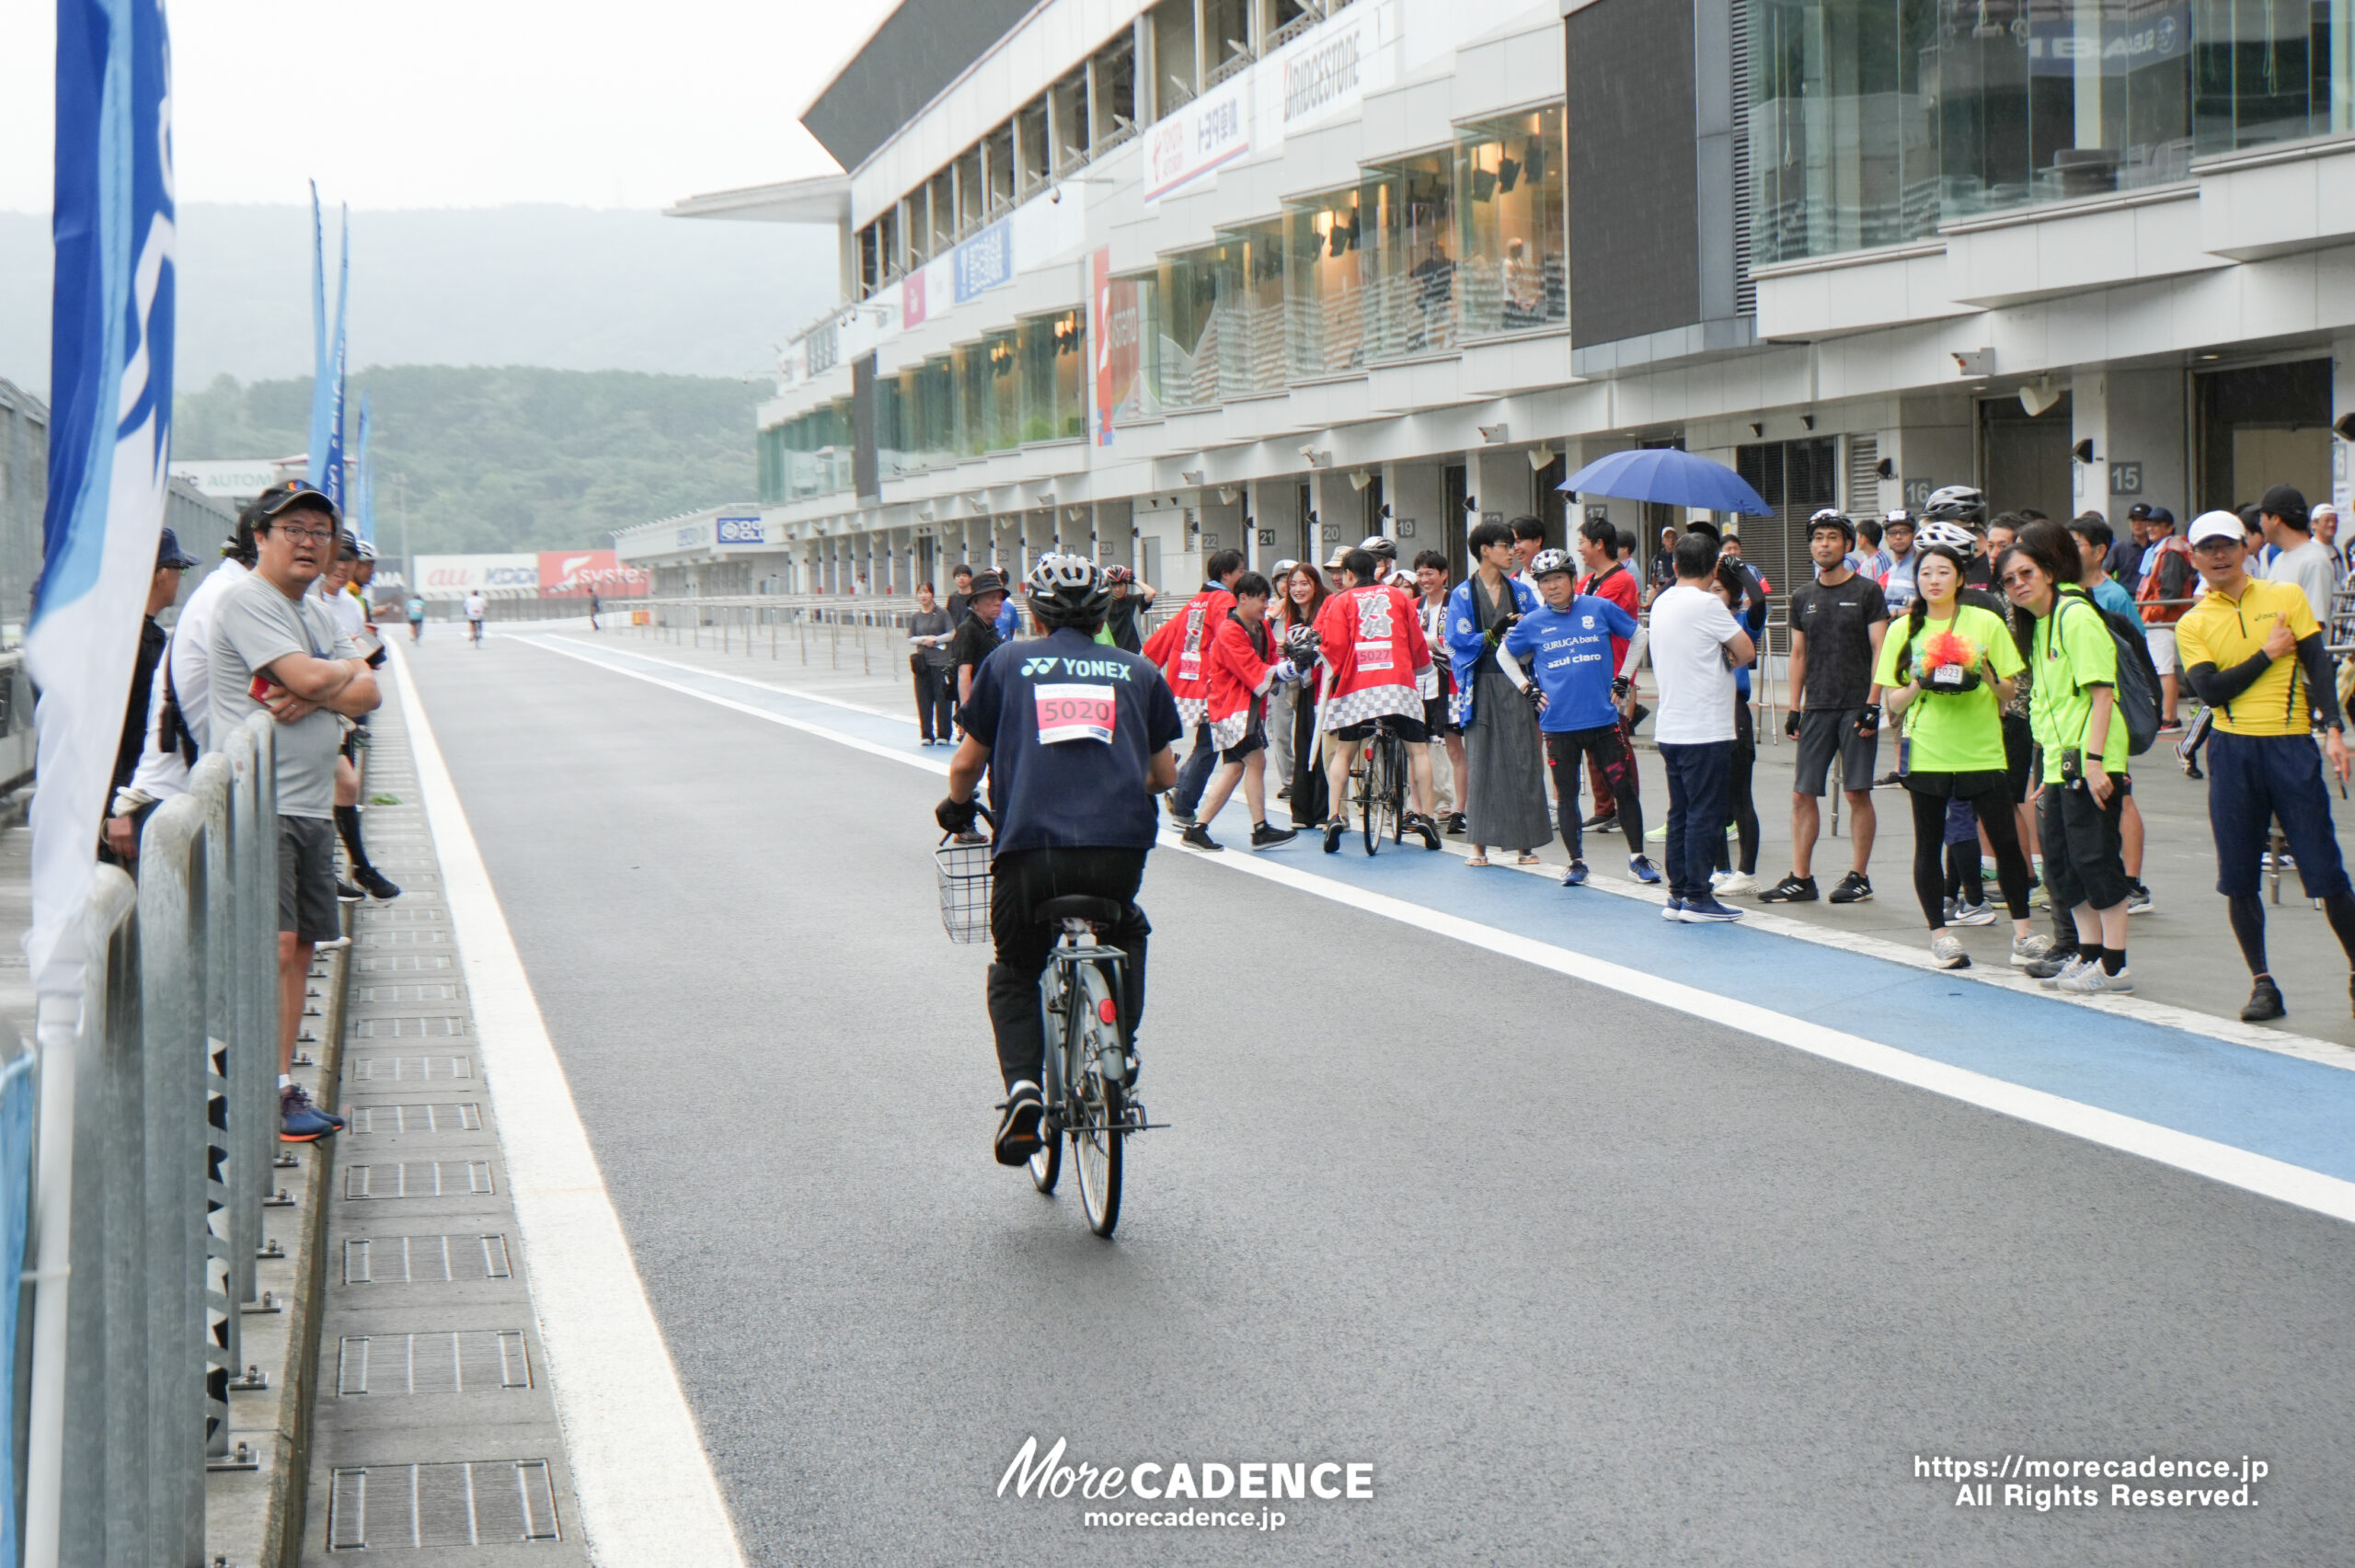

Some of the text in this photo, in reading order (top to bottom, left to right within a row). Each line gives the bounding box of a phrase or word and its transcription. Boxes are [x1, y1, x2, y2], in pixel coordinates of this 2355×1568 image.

[1283, 29, 1361, 123] BRIDGESTONE
[2112, 466, 2139, 490] 15
[1906, 483, 1930, 504] 16
[1324, 527, 1339, 541] 20
[1397, 521, 1414, 536] 19
[1203, 535, 1217, 547] 22
[1259, 532, 1274, 545] 21
[1099, 543, 1112, 554] 23
[428, 567, 537, 586] au KDDI
[1542, 634, 1600, 652] SURUGA bank
[1359, 649, 1391, 662] 5027
[1547, 653, 1602, 670] azul claro
[1062, 657, 1132, 681] YONEX
[1936, 667, 1959, 678] 5023
[1044, 700, 1110, 722] 5020
